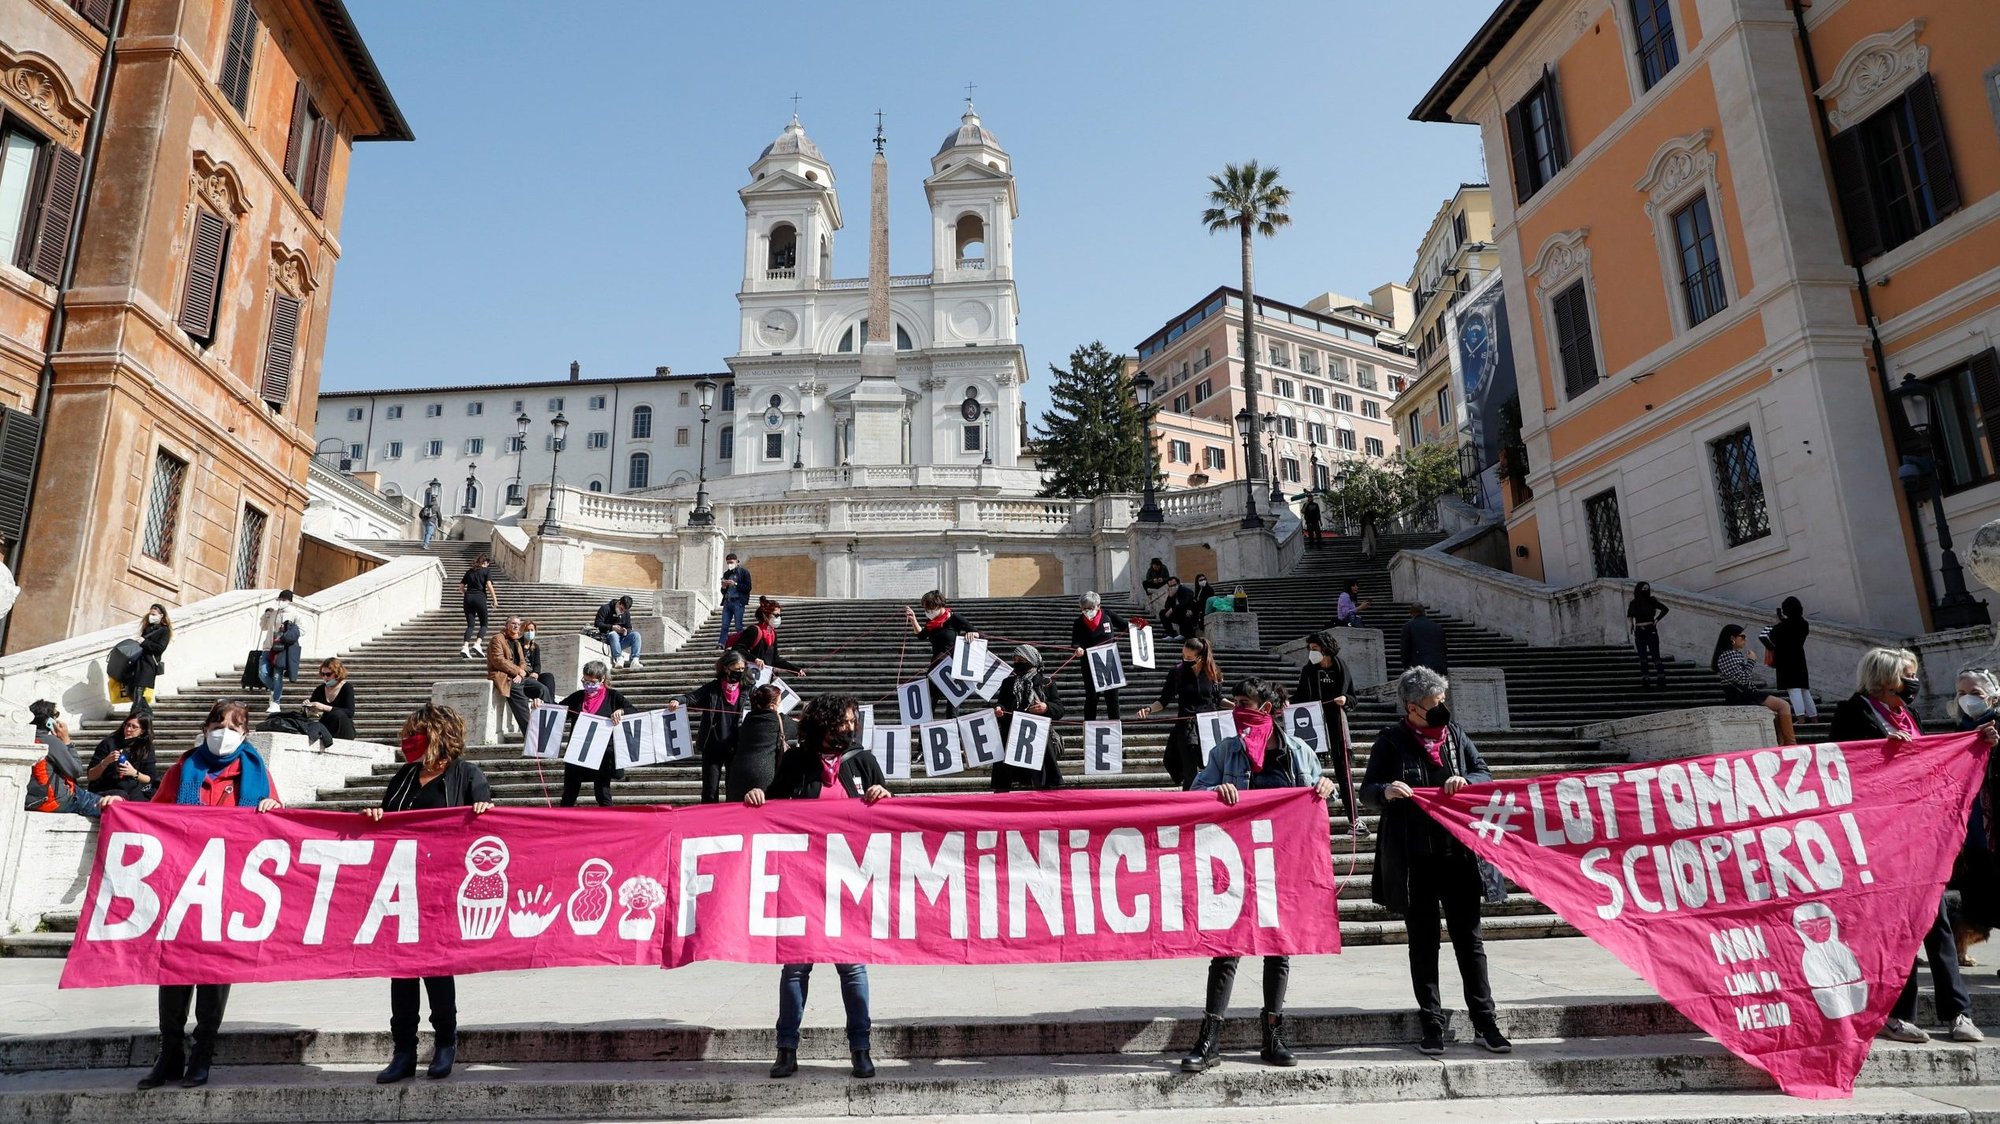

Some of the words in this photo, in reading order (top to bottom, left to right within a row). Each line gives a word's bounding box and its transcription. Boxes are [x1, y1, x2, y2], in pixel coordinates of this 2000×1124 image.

[537, 710, 681, 763] VIVE
[1468, 742, 1853, 846] #LOTTOMARZO
[86, 831, 420, 945] BASTA
[1709, 924, 1770, 966] NON
[1734, 1001, 1791, 1032] MENO
